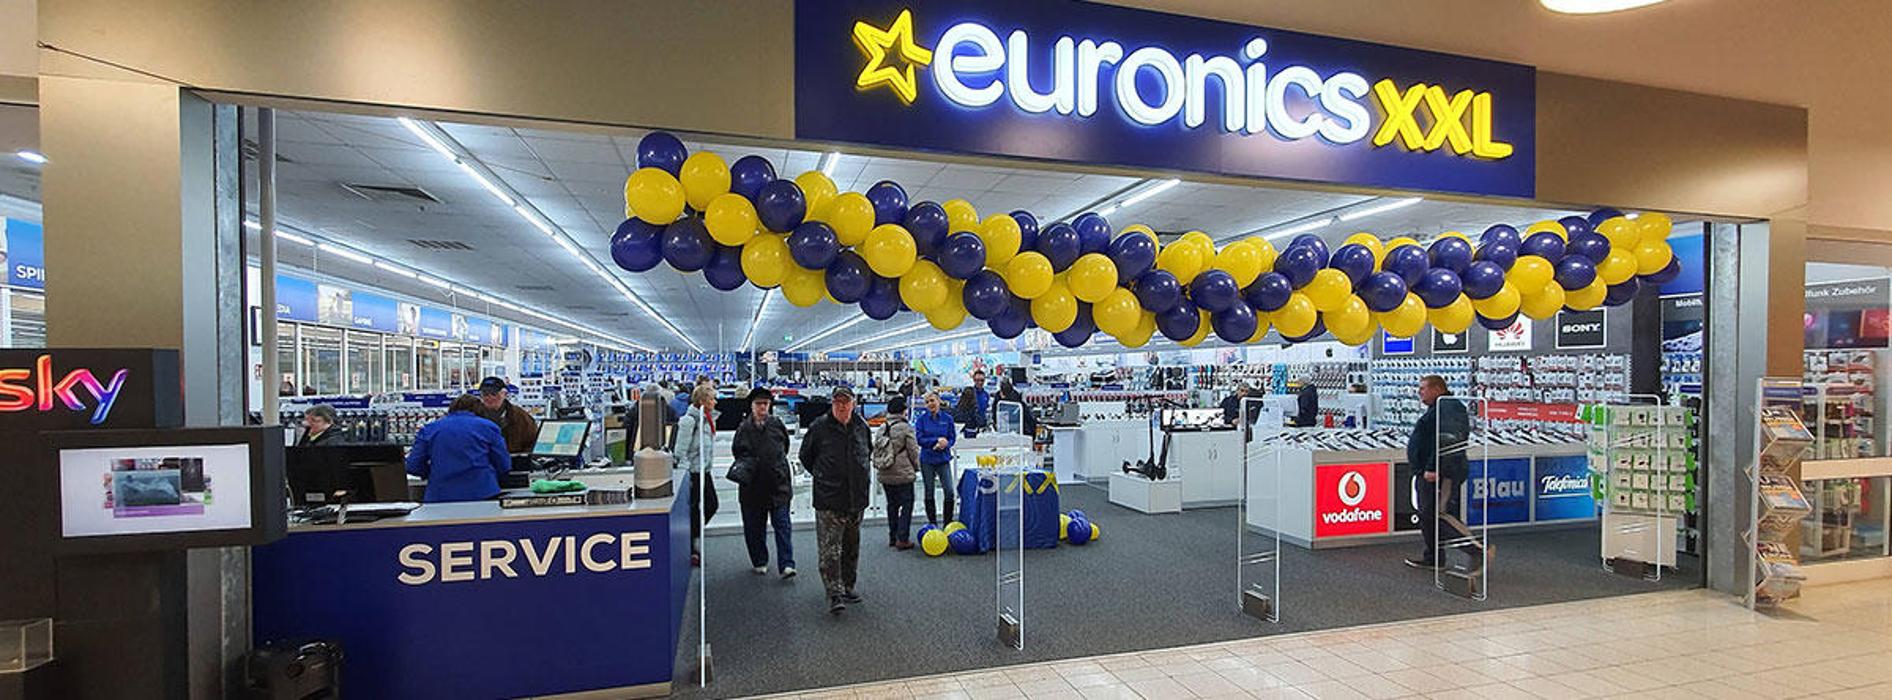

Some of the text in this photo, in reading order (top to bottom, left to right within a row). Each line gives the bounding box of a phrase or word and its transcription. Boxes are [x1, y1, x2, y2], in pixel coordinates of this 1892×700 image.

[933, 21, 1513, 159] euronics XXL
[1562, 322, 1601, 333] SONY
[0, 354, 129, 425] sky
[1473, 477, 1525, 499] Blau
[1322, 507, 1383, 524] vodafone
[397, 531, 652, 586] SERVICE
